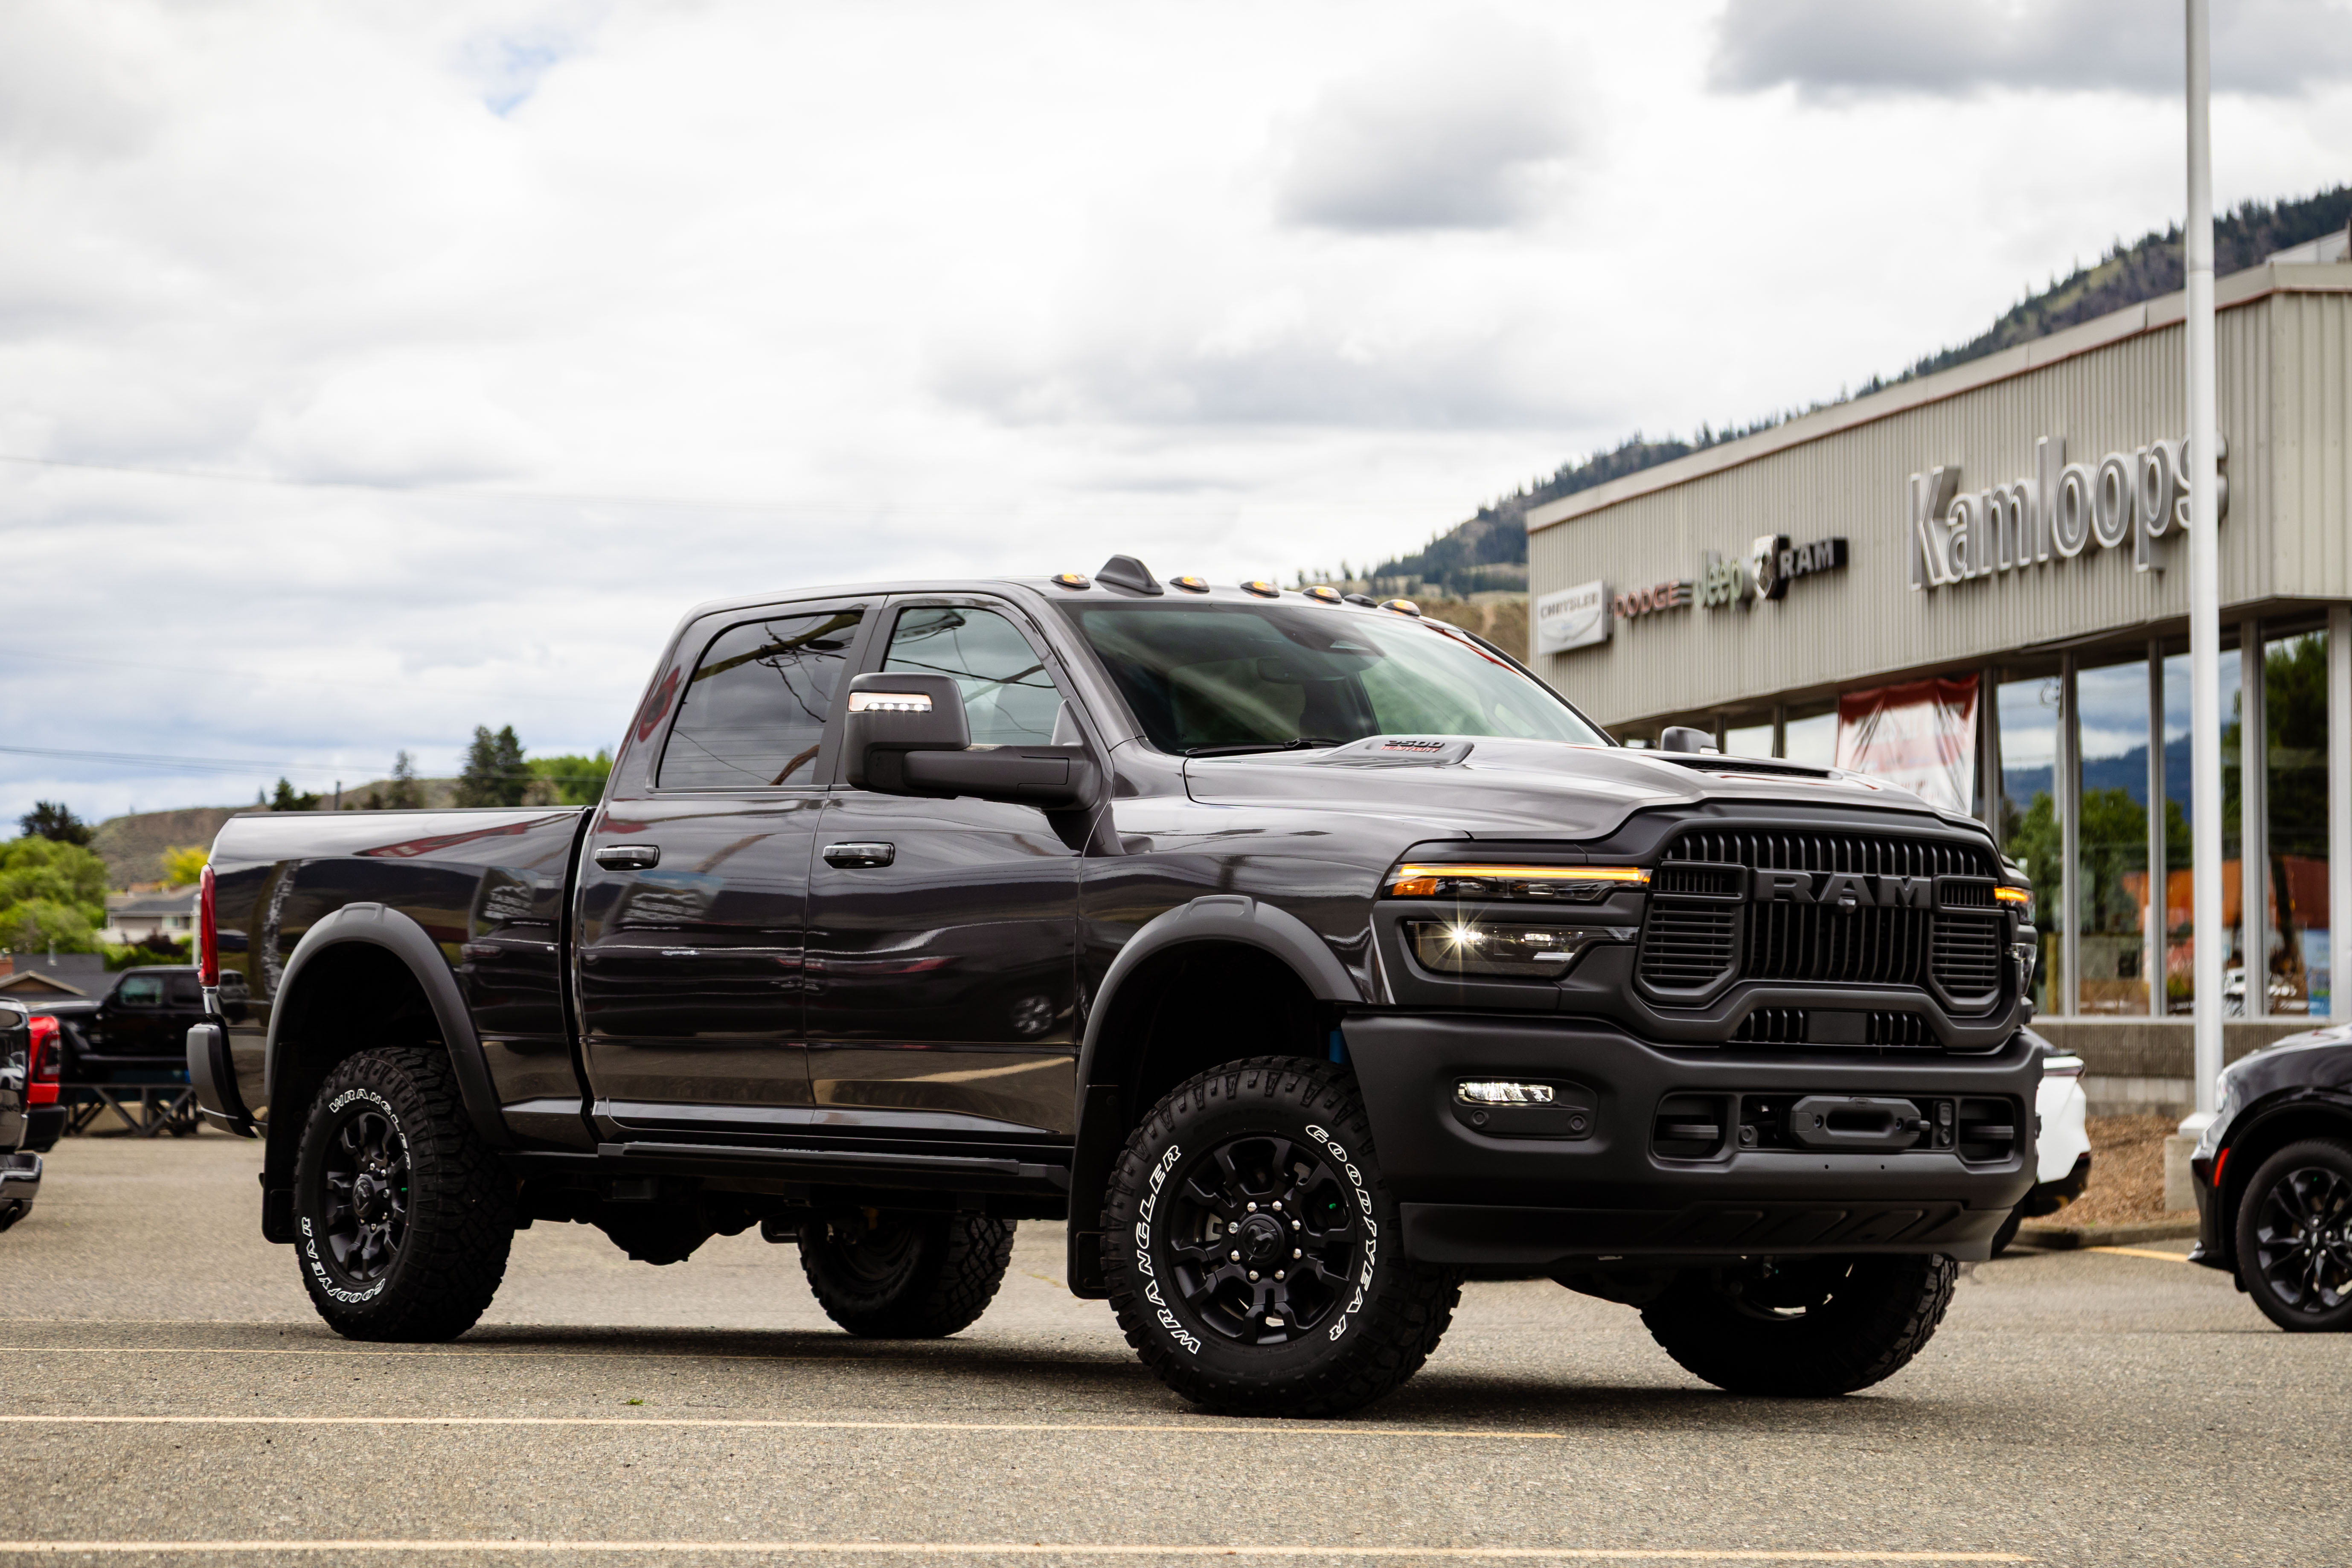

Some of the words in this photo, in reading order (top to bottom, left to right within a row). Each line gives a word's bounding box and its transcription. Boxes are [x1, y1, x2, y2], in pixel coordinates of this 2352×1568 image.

[1909, 432, 2225, 591] Kamloops
[1694, 550, 1743, 611] Jeep
[1779, 538, 1835, 579] RAM
[1540, 593, 1600, 619] CHRYSLER
[1614, 579, 1680, 618] DODGE
[1755, 869, 1931, 908] RAM
[329, 1089, 411, 1169] WRANGLER
[301, 1217, 386, 1303] GOODYEAR
[1136, 1145, 1201, 1354] WRANGLER
[1305, 1124, 1377, 1341] GOODYEAR
